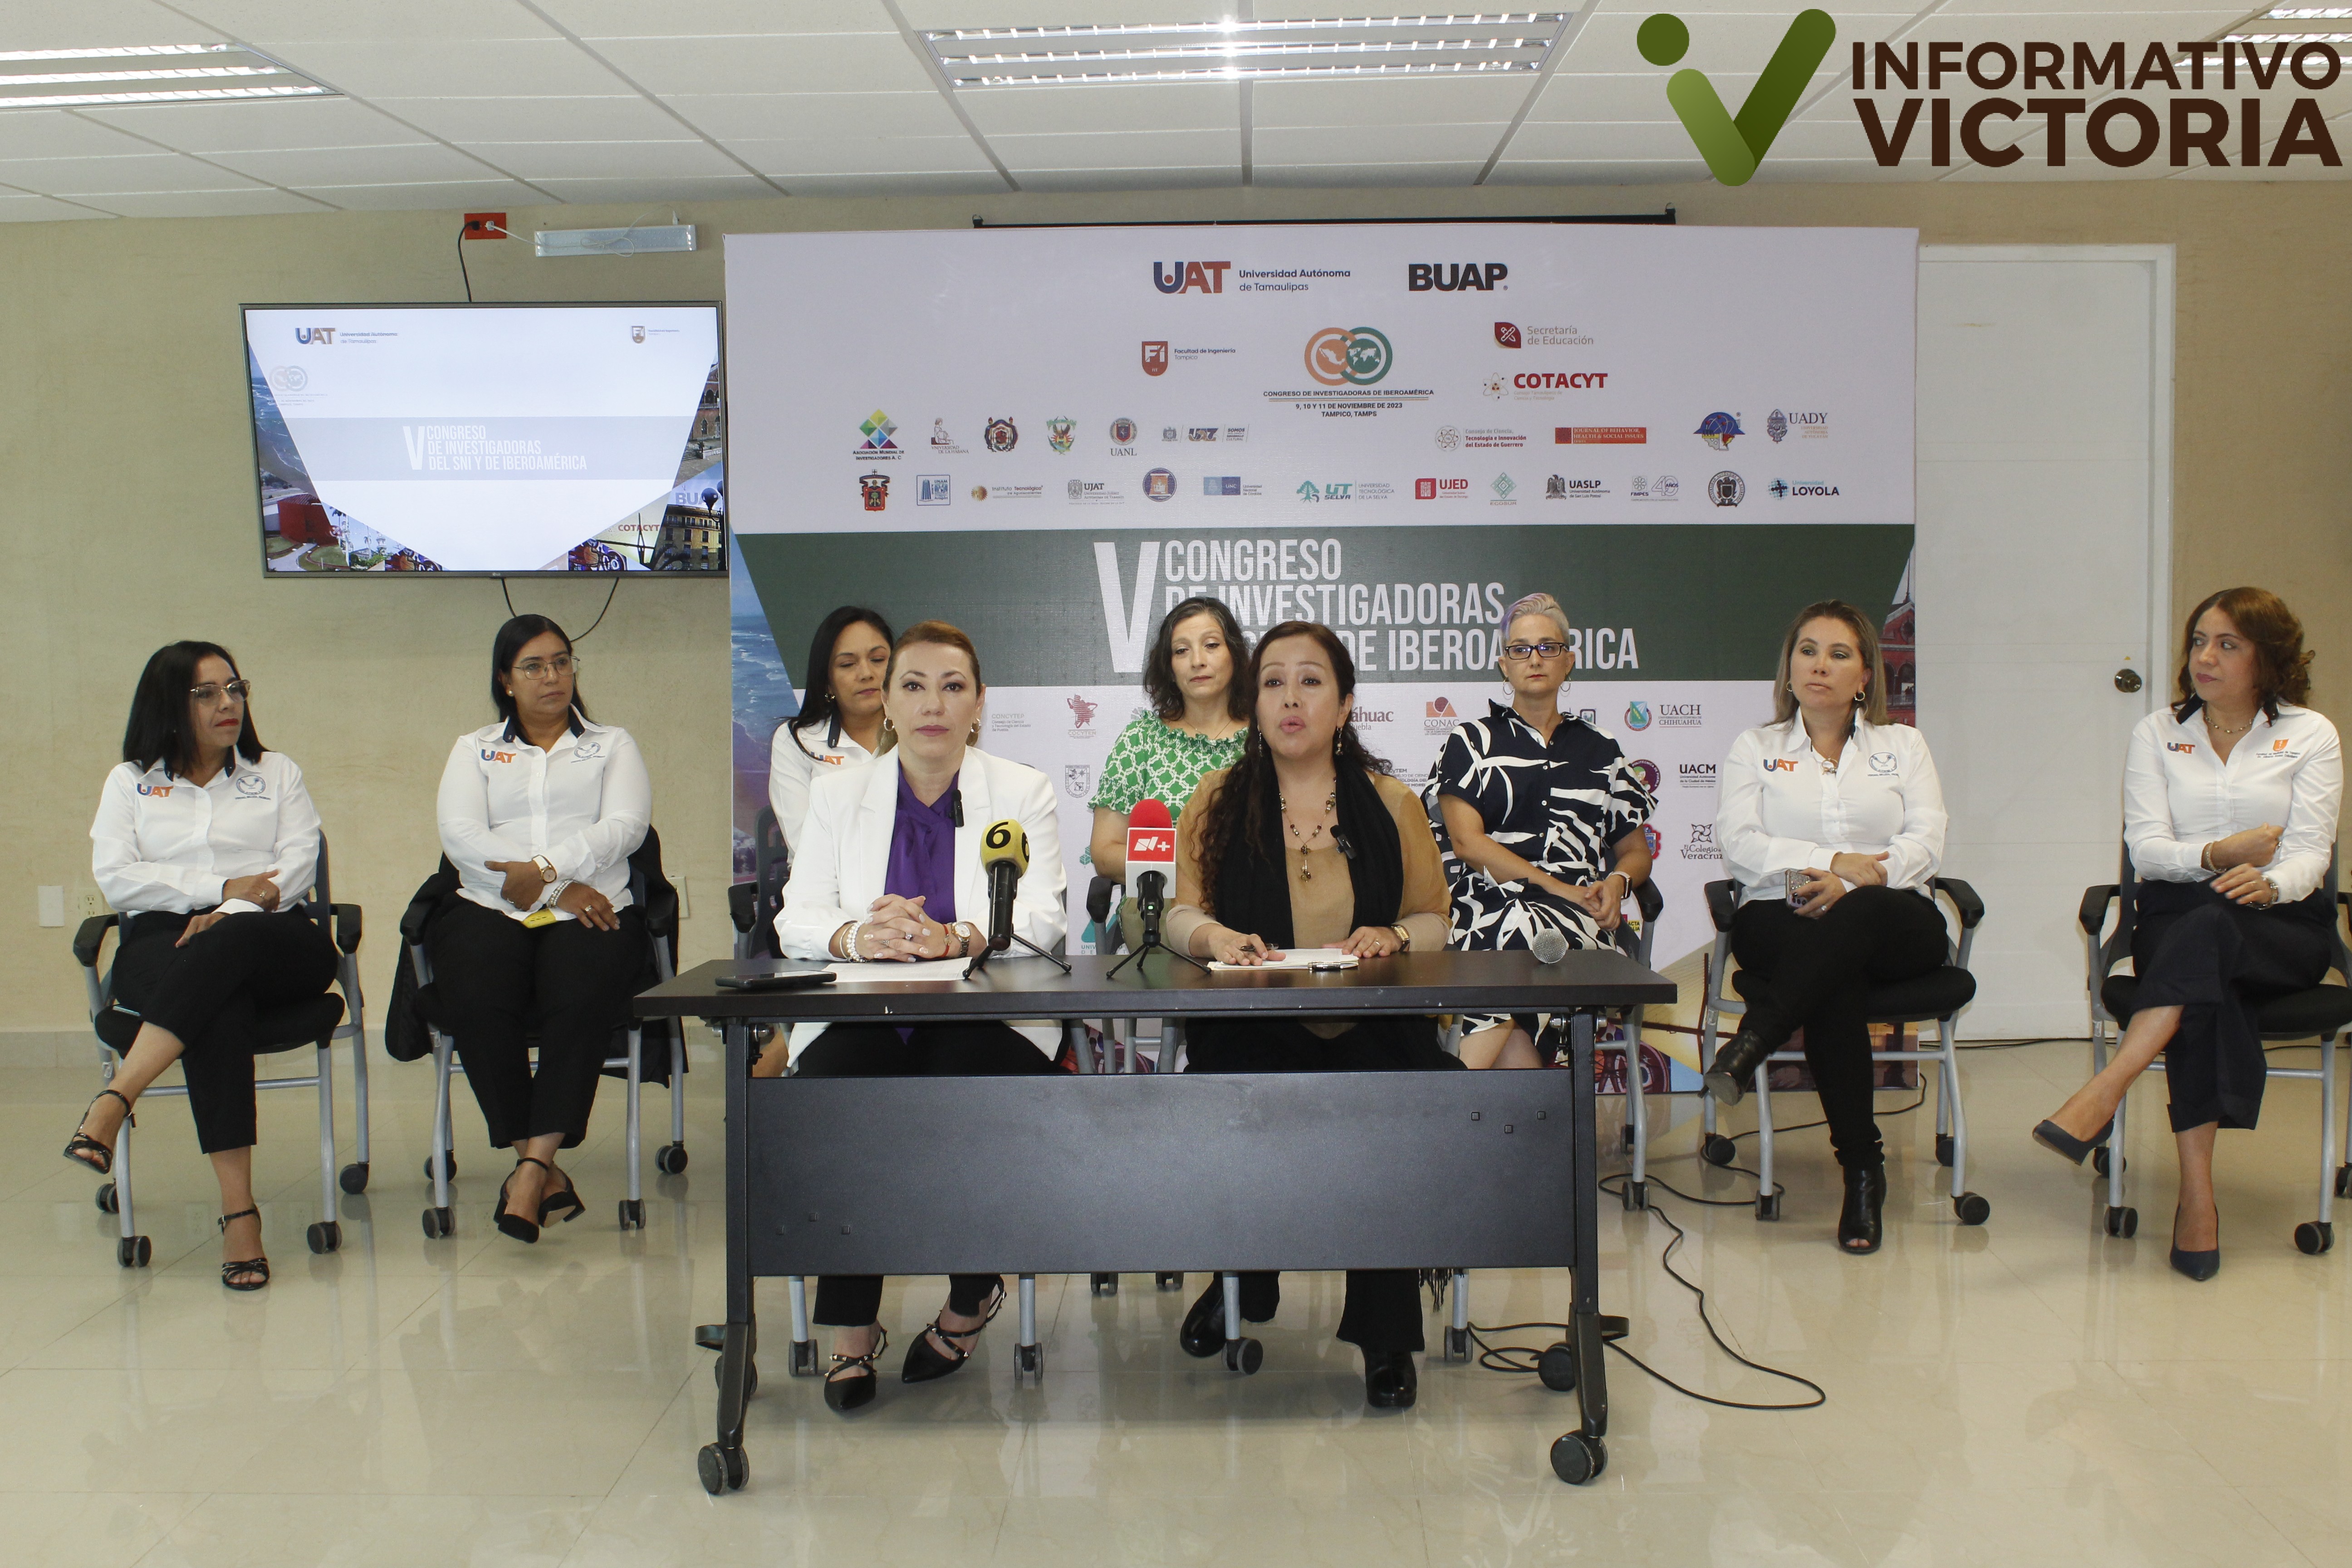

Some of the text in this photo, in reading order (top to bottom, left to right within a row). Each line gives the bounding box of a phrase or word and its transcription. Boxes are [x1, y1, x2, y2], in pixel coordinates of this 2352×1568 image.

[1153, 261, 1231, 294] UAT
[1239, 269, 1351, 278] Universidad Autónoma
[1408, 263, 1508, 291] BUAP
[1240, 282, 1309, 292] de Tamaulipas
[295, 328, 336, 345] UAT
[1527, 325, 1577, 335] Secretaría
[1528, 335, 1593, 345] de Educación
[1514, 373, 1608, 388] COTACYT
[1788, 413, 1828, 424] UADY
[426, 425, 486, 440] CONGRESO
[402, 426, 425, 470] V
[428, 440, 542, 455] DE INVESTIGADORAS
[429, 453, 587, 470] DEL SNI Y DE IBEROAMÉRICA
[1439, 479, 1468, 490] UJED
[1569, 480, 1601, 489] UASLP
[1792, 486, 1839, 495] LOYOLA
[1165, 539, 1342, 582] CONGRESO
[1094, 541, 1160, 673] V
[1660, 705, 1701, 715] UACH
[2167, 742, 2195, 754] UAT
[481, 749, 516, 763] UAT
[1680, 764, 1716, 774] UACM
[1764, 758, 1798, 772] UAT
[137, 783, 174, 798] UAT
[986, 822, 1011, 849] 6
[1680, 849, 1723, 859] Veracruz
[1689, 844, 1718, 853] Colegio
